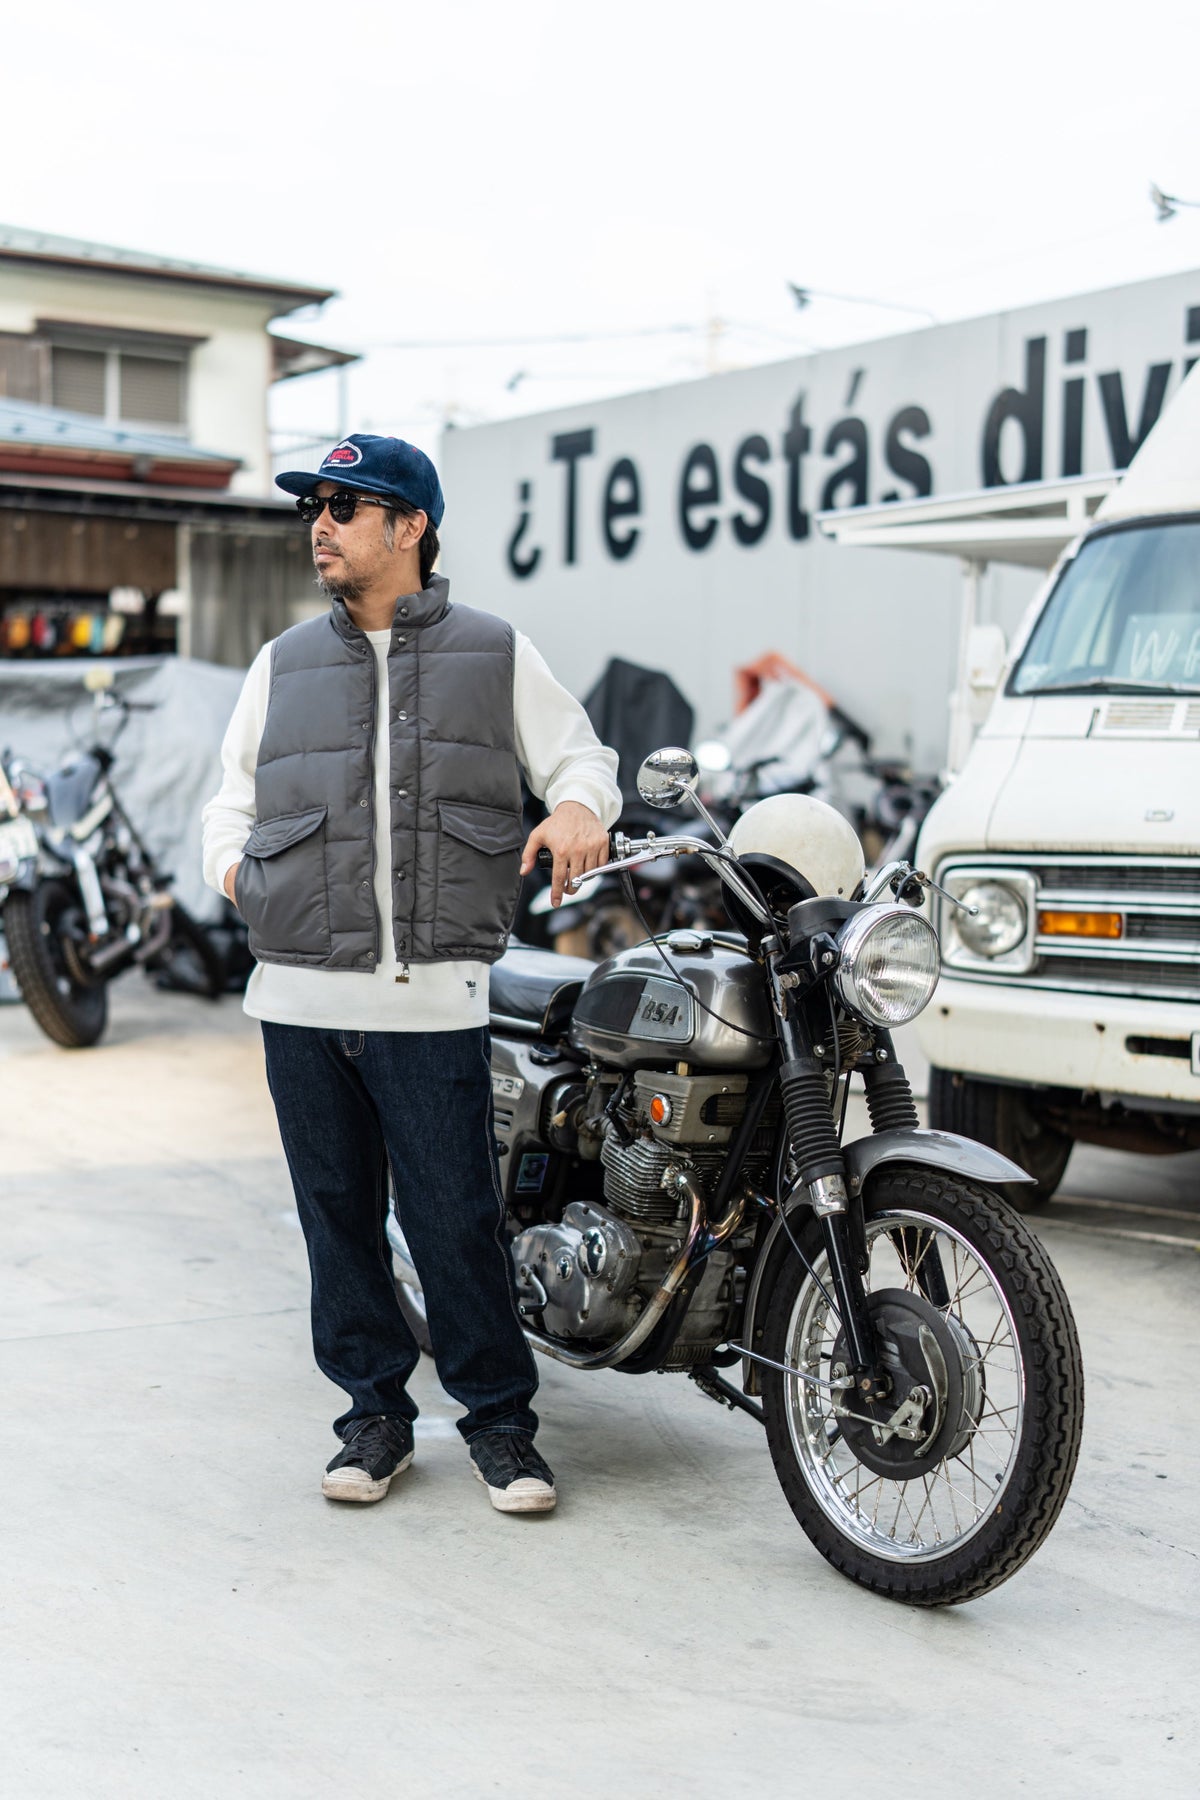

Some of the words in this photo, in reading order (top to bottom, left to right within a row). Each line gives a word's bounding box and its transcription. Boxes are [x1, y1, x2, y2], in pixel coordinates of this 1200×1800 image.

[506, 427, 643, 579] ¿Te
[678, 366, 934, 553] estás
[641, 1000, 680, 1026] BSA
